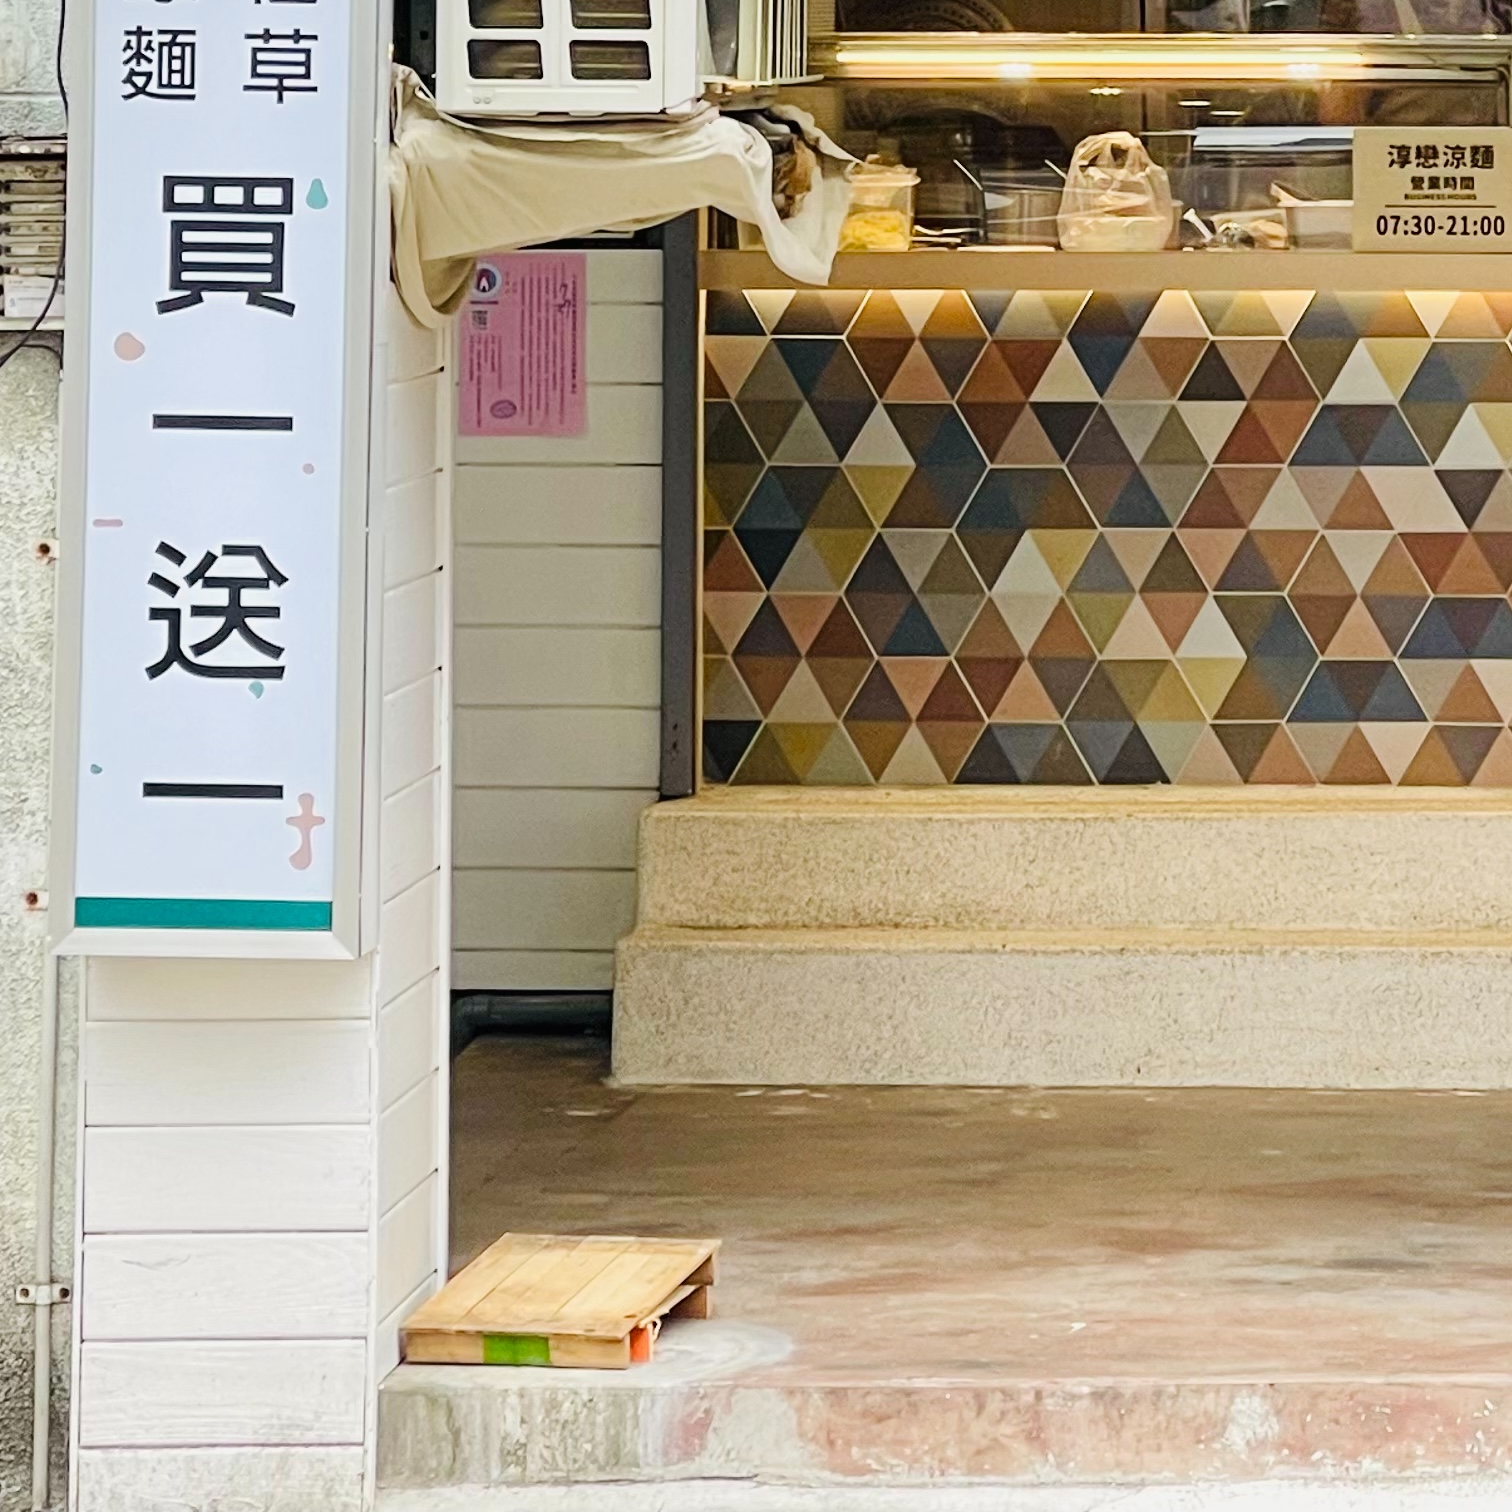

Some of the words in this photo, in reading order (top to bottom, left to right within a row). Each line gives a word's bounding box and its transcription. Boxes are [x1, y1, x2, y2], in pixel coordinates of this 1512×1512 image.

[1387, 144, 1495, 170] 淳戀涼麵
[1376, 214, 1505, 236] 07:30-21:00
[143, 175, 296, 800] 買一送一
